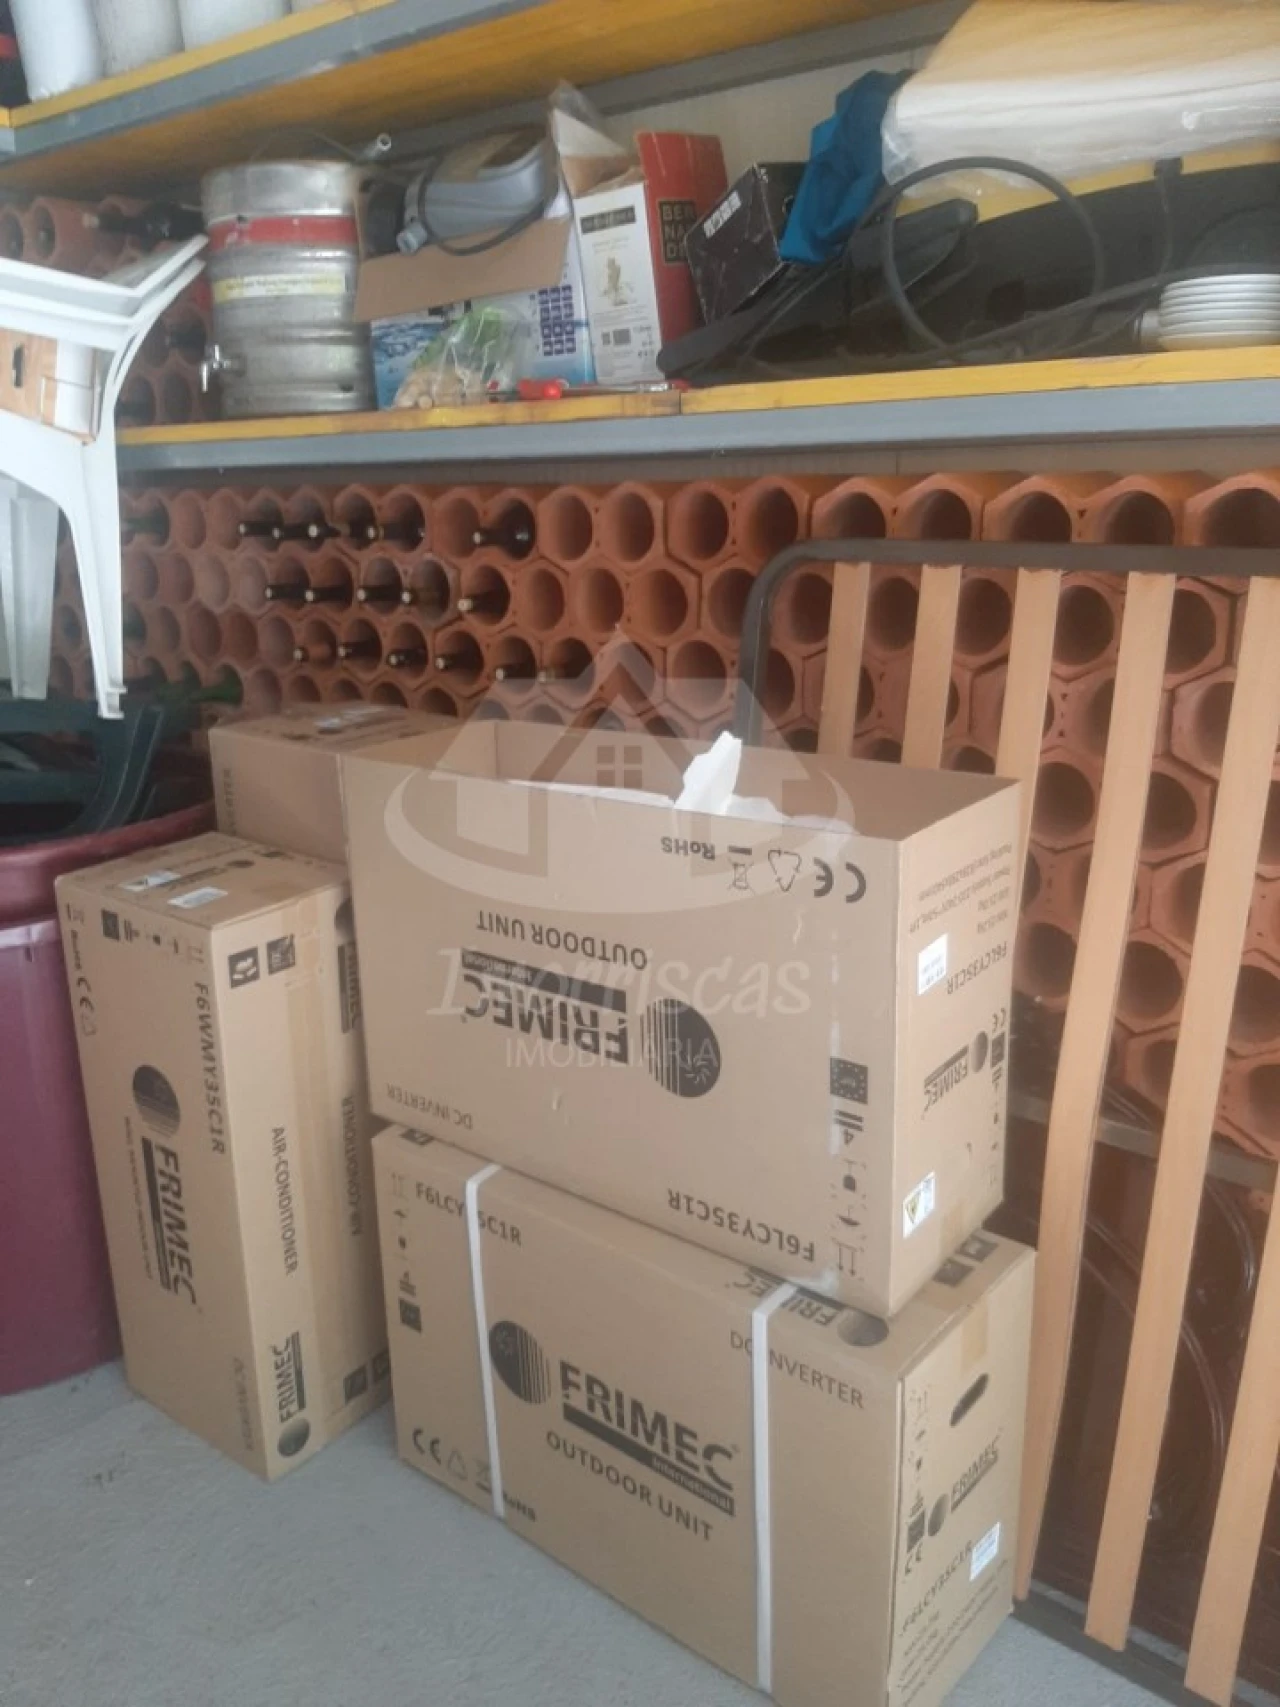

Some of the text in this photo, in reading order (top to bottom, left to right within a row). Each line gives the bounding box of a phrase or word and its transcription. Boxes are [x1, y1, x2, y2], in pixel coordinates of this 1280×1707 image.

[660, 837, 716, 861] RoHS
[476, 910, 648, 970] OUTDOOR UNIT
[463, 974, 630, 1065] FRIMEC
[386, 1082, 474, 1131] DC INVERTER
[923, 1056, 968, 1112] FRIMEC
[154, 1142, 197, 1306] FRIMEC
[271, 1126, 299, 1277] AIR-CONDITIONER
[667, 1188, 816, 1262] F6LCY35C1R
[272, 1335, 296, 1424] FRIMEC
[768, 1348, 865, 1409] NVERTER
[559, 1359, 734, 1492] FRIMEC
[545, 1429, 714, 1541] OUTDOOR UNIT
